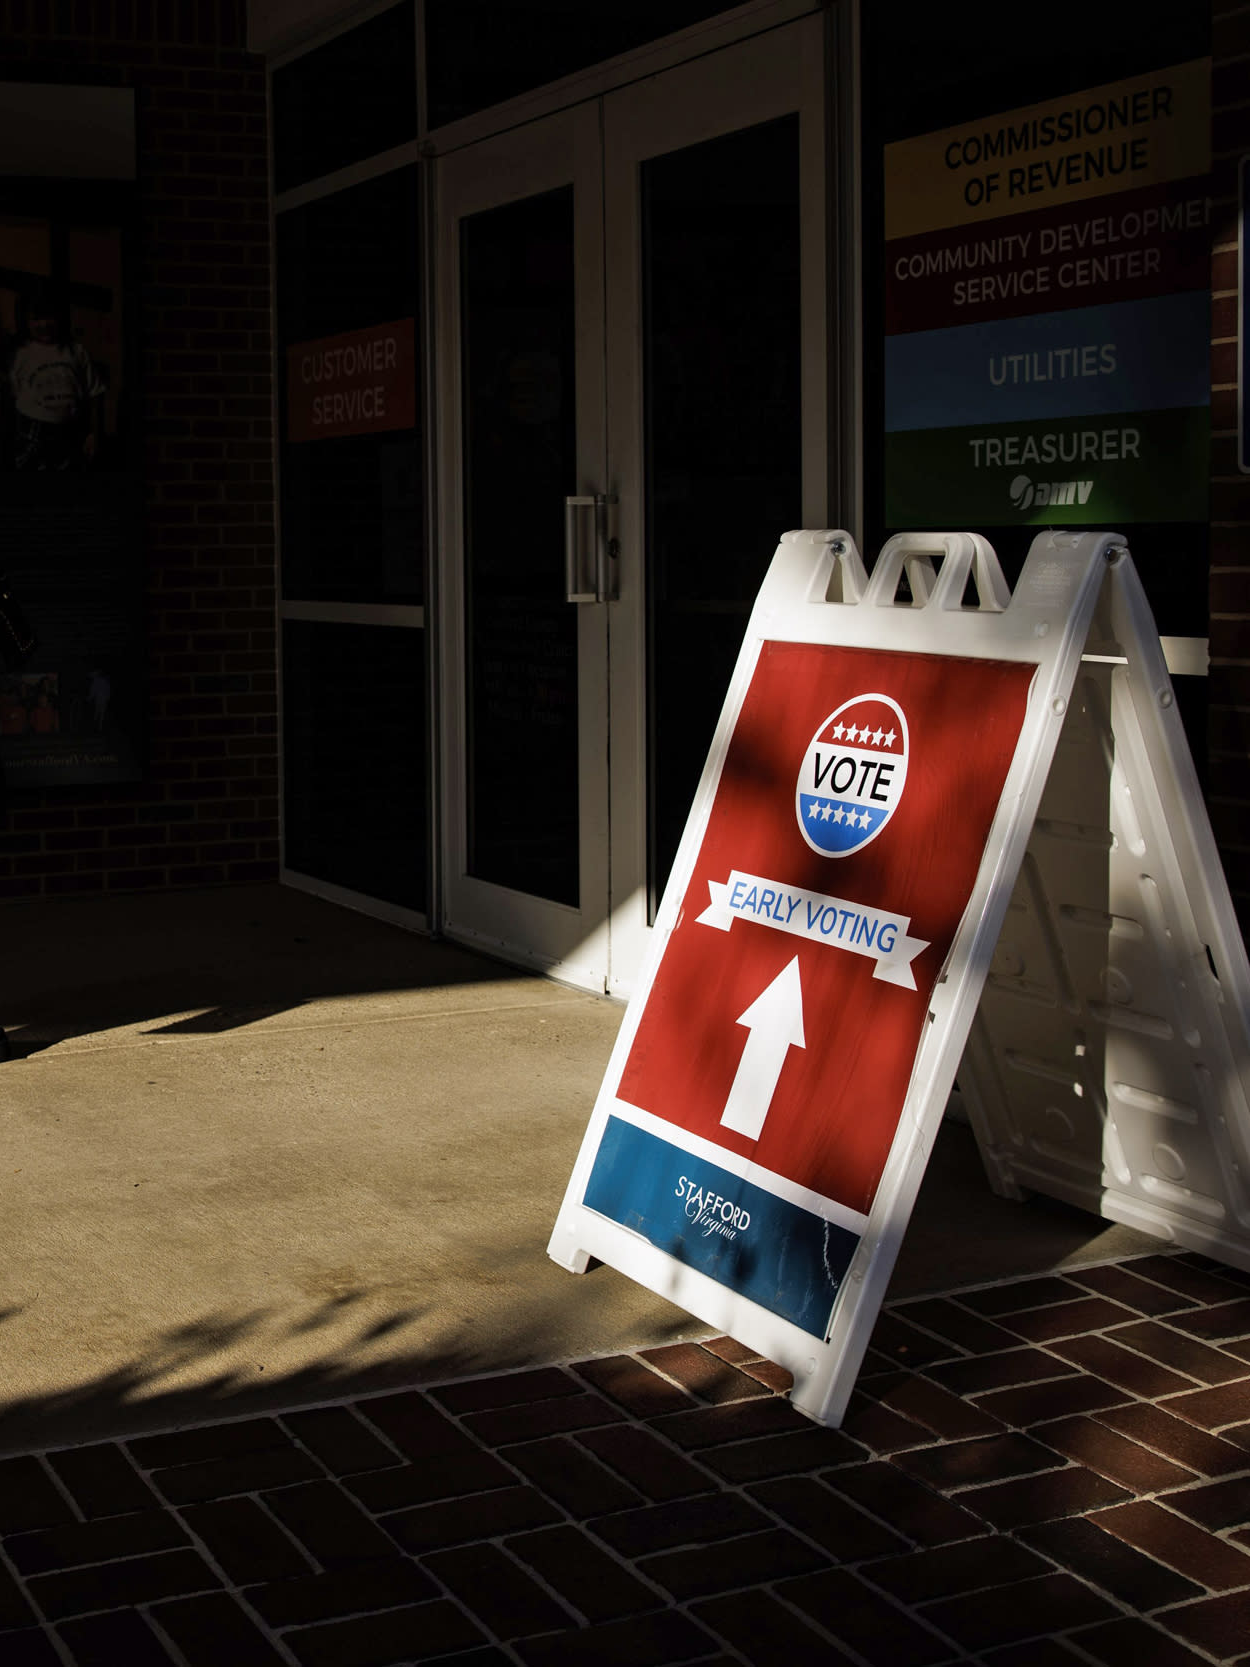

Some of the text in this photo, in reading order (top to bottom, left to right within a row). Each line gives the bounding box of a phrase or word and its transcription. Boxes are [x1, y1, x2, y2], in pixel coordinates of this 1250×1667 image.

[944, 86, 1173, 169] COMMISSIONER
[965, 138, 1149, 206] OF REVENUE
[894, 232, 1033, 281] COMMUNITY
[952, 248, 1162, 306] SERVICE CENTER
[301, 337, 398, 384] CUSTOMER
[989, 343, 1117, 386] UTILITIES
[312, 385, 385, 424] SERVICE
[969, 427, 1141, 468] TREASURER
[1034, 480, 1094, 506] DMV
[814, 752, 895, 802] VOTE
[729, 881, 898, 953] EARLY VOTING
[675, 1176, 751, 1231] STAFFORD
[685, 1197, 738, 1240] Virginia
